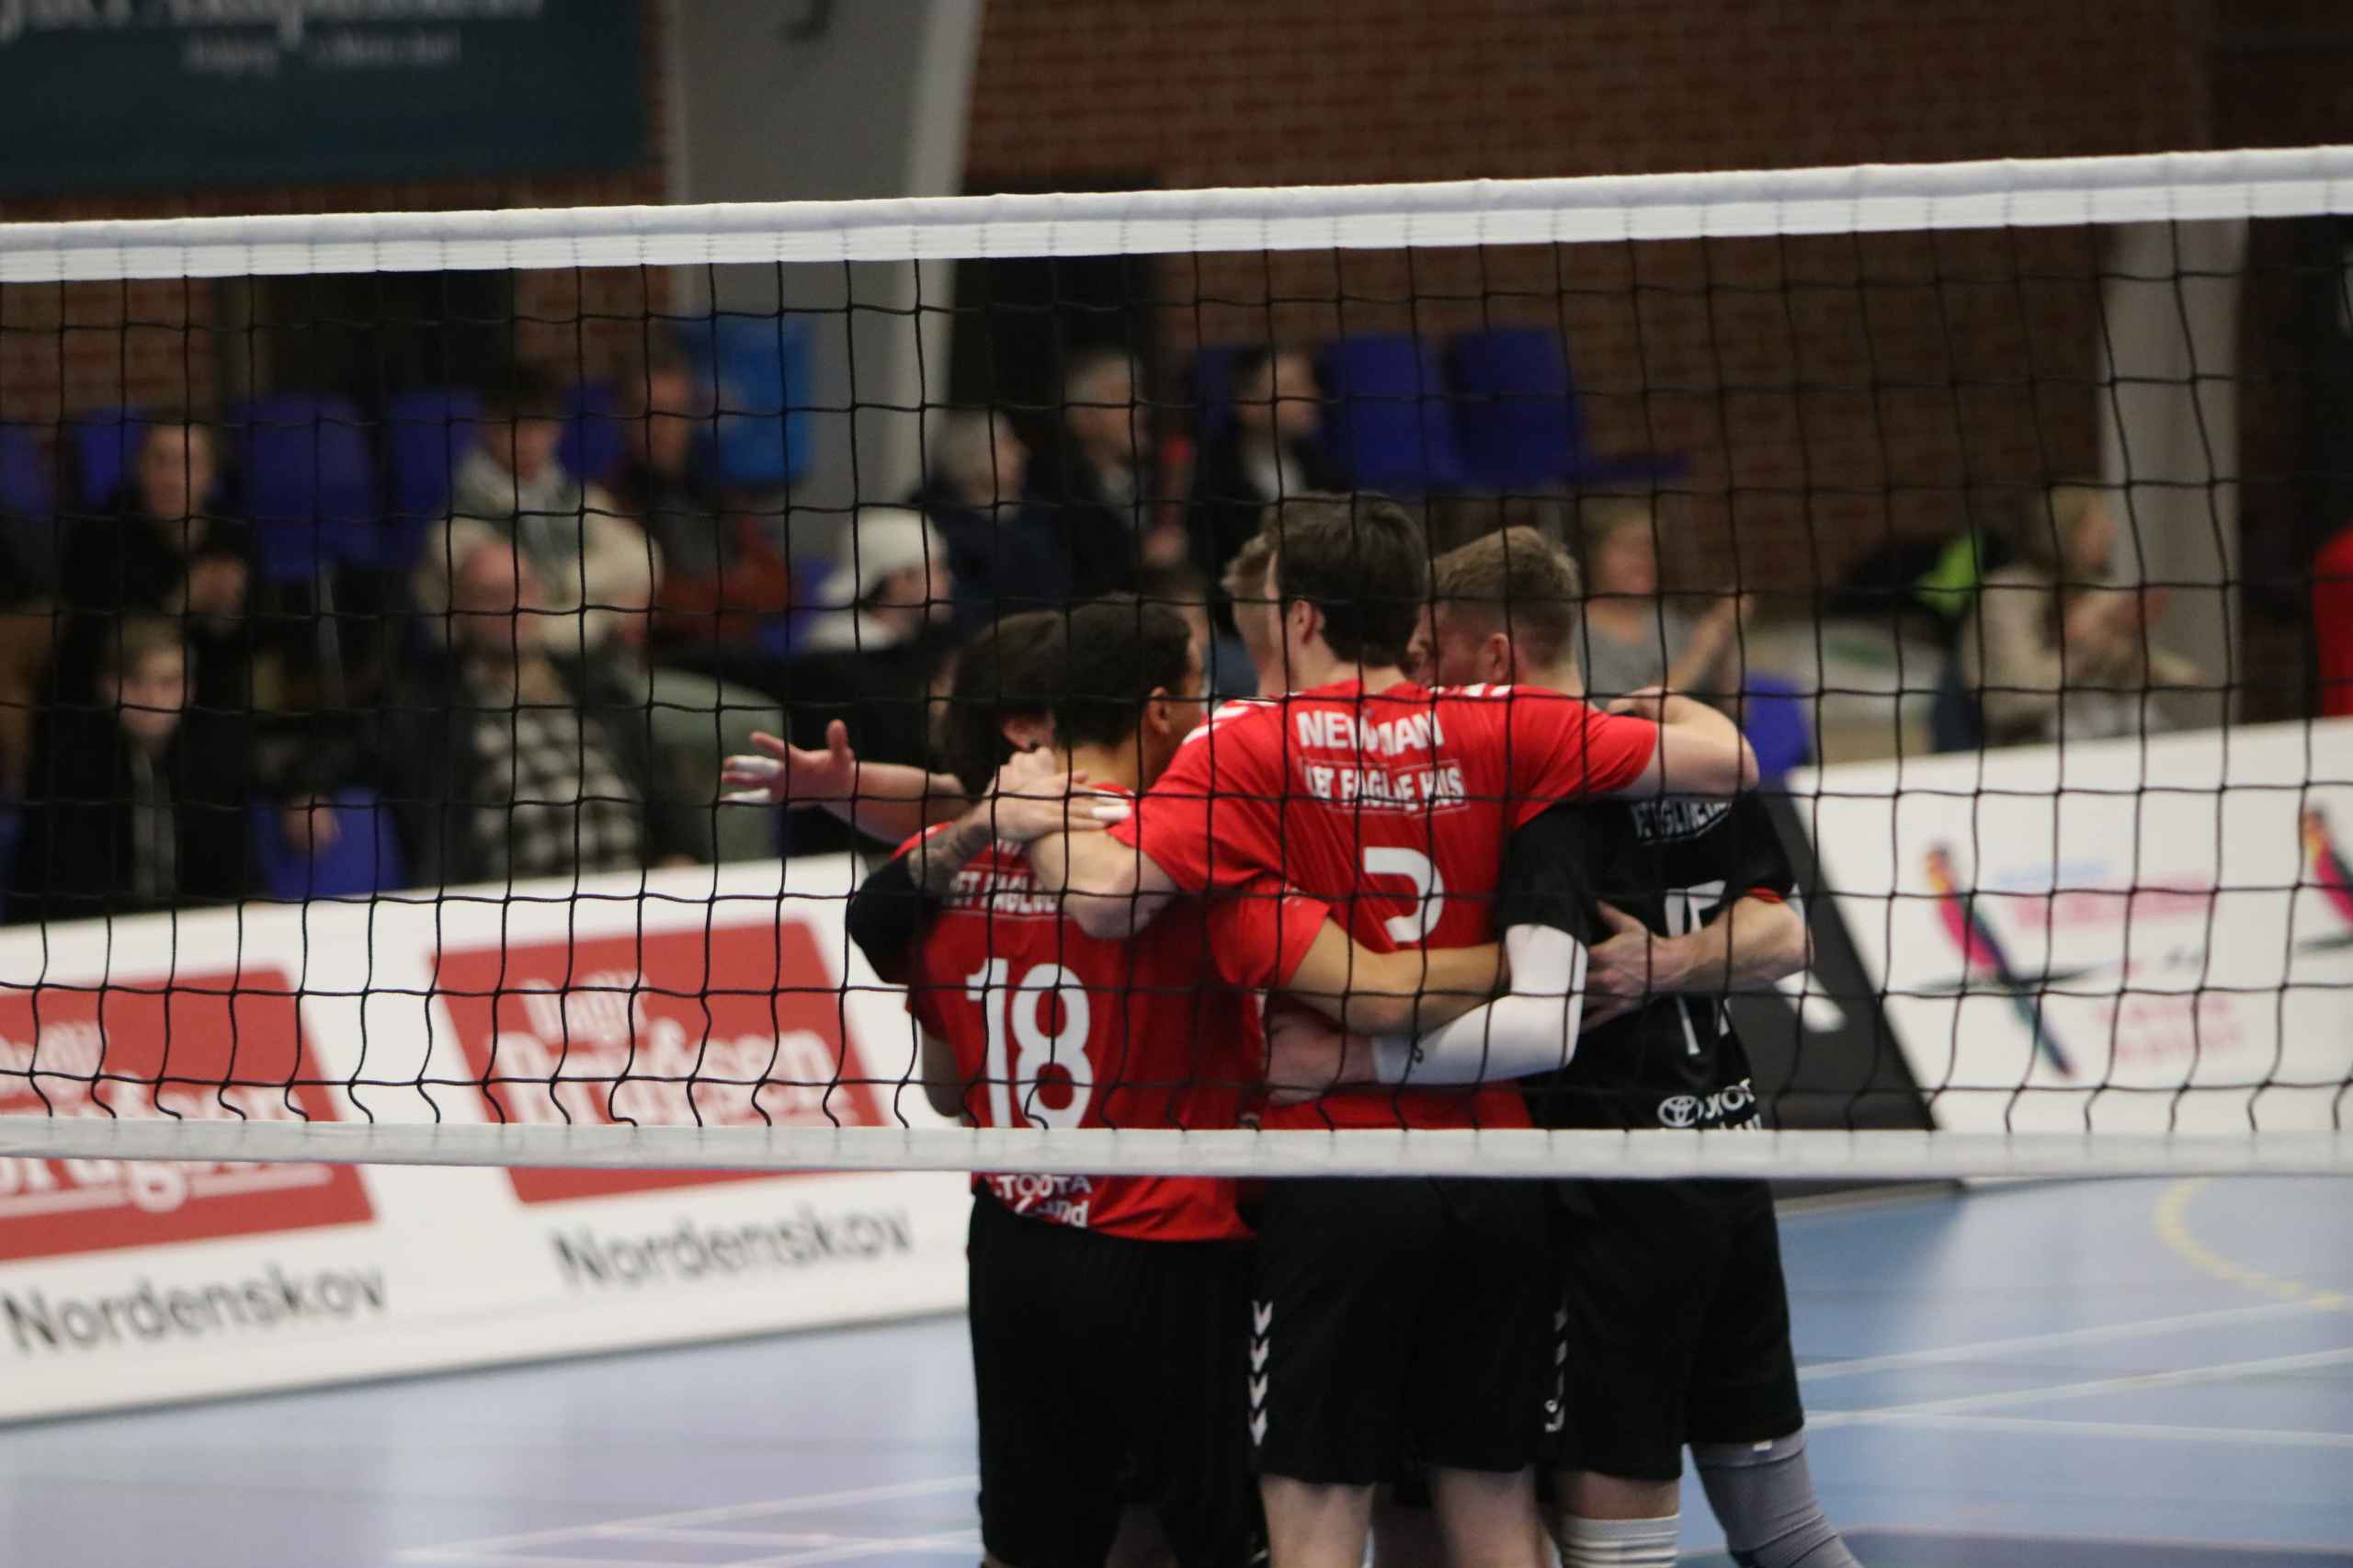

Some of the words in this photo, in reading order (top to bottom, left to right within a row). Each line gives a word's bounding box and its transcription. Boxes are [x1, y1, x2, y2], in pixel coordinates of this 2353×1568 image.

[966, 957, 1095, 1129] 18
[551, 1204, 913, 1288] Nordenskov
[2, 1264, 389, 1352] Nordenskov
